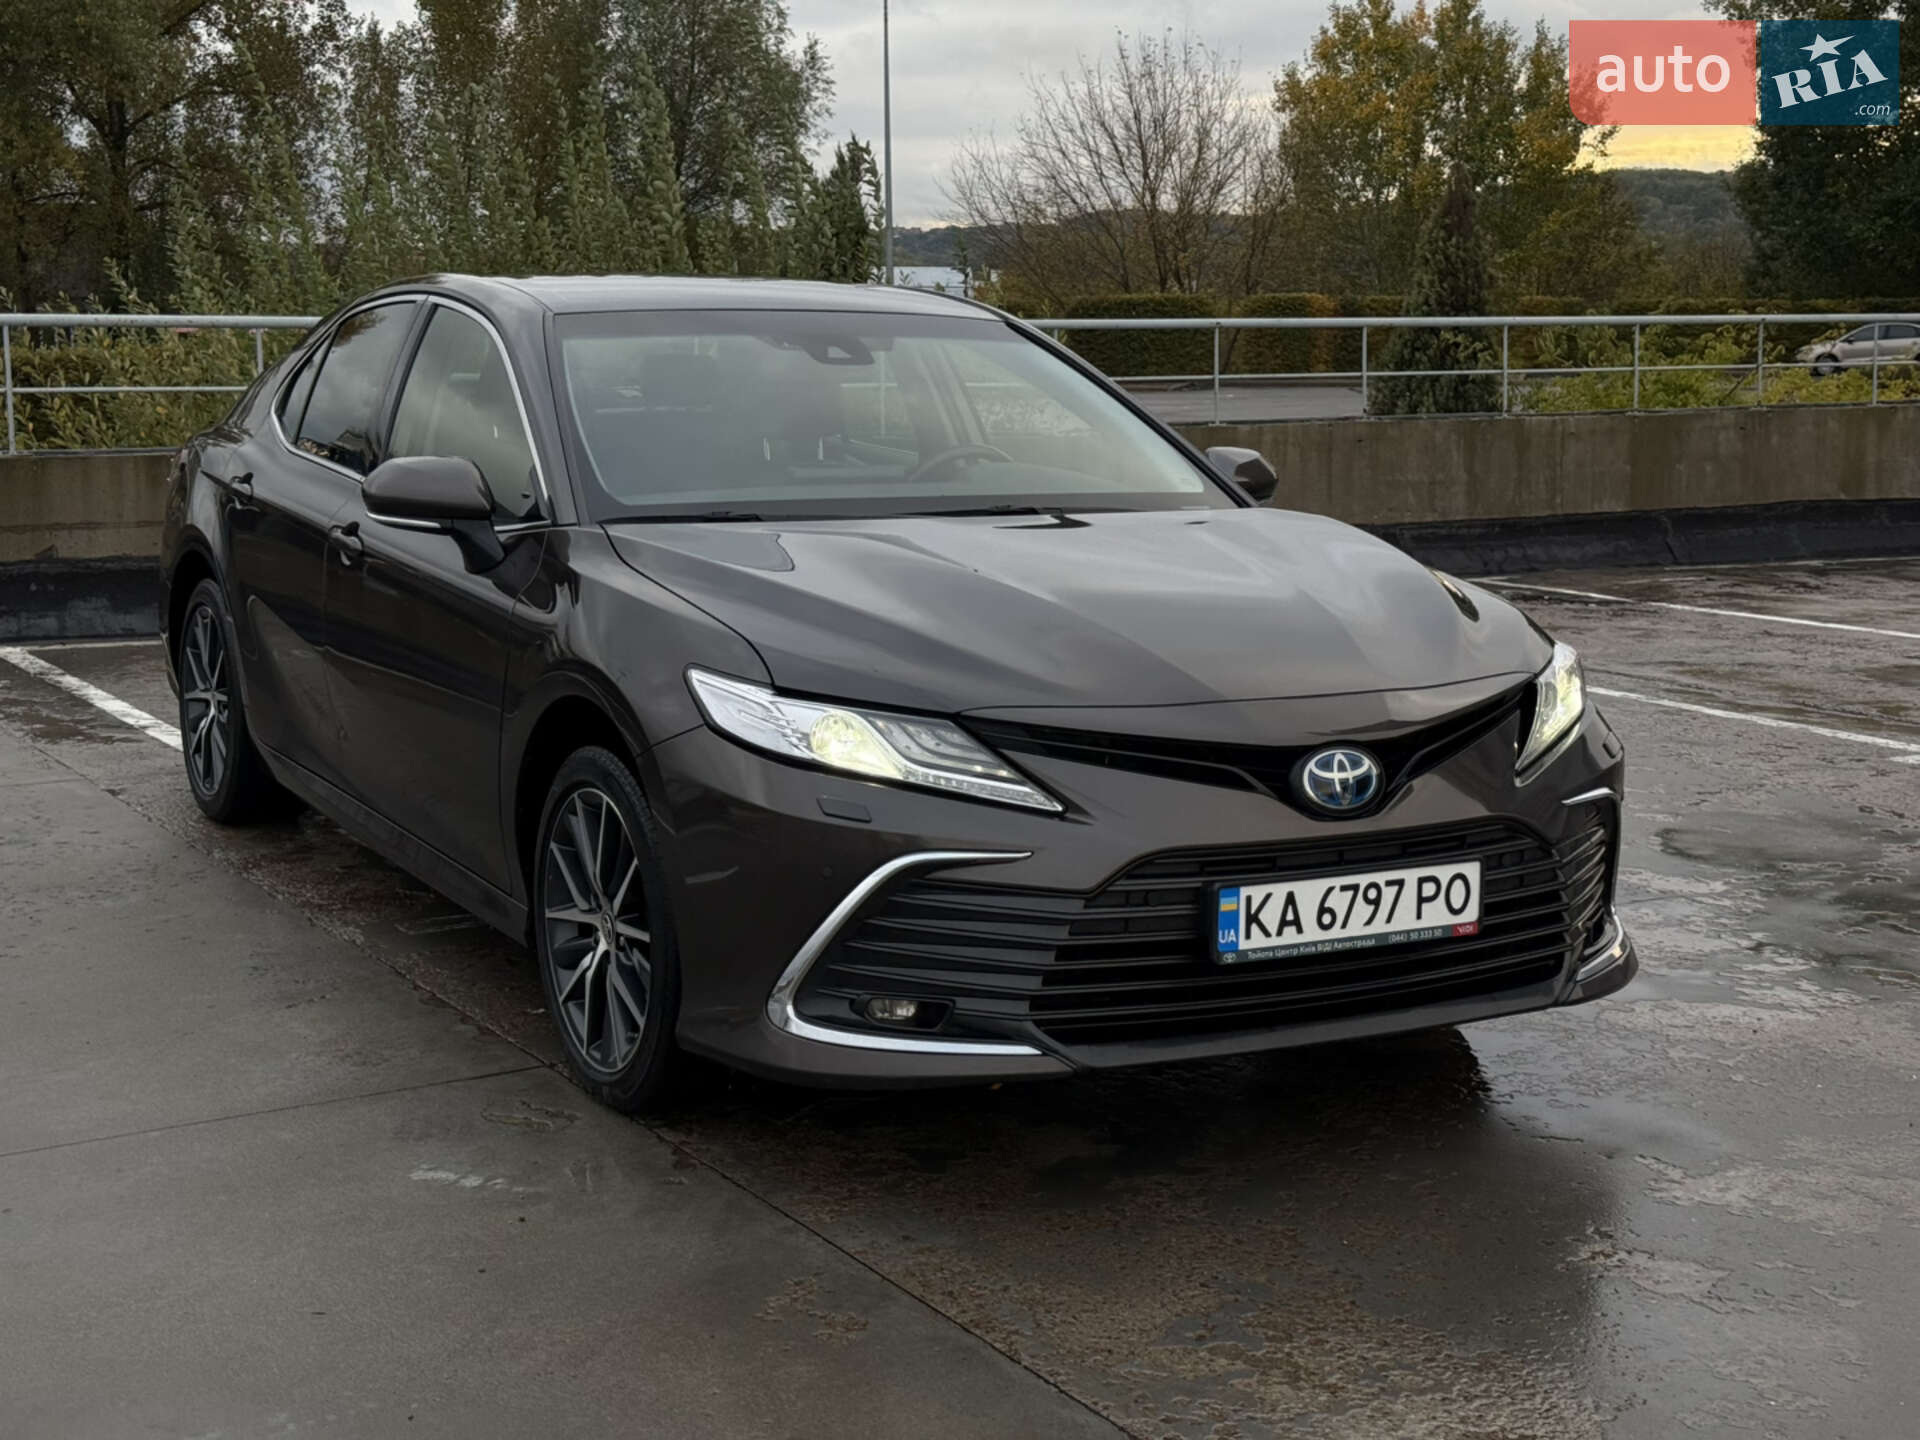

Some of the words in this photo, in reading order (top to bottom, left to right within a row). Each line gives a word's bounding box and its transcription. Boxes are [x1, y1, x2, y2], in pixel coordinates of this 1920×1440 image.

[1244, 890, 1304, 941] KA
[1316, 878, 1406, 932] 6797
[1415, 872, 1472, 921] PO
[1218, 929, 1237, 944] UA
[1274, 947, 1299, 958] Центр
